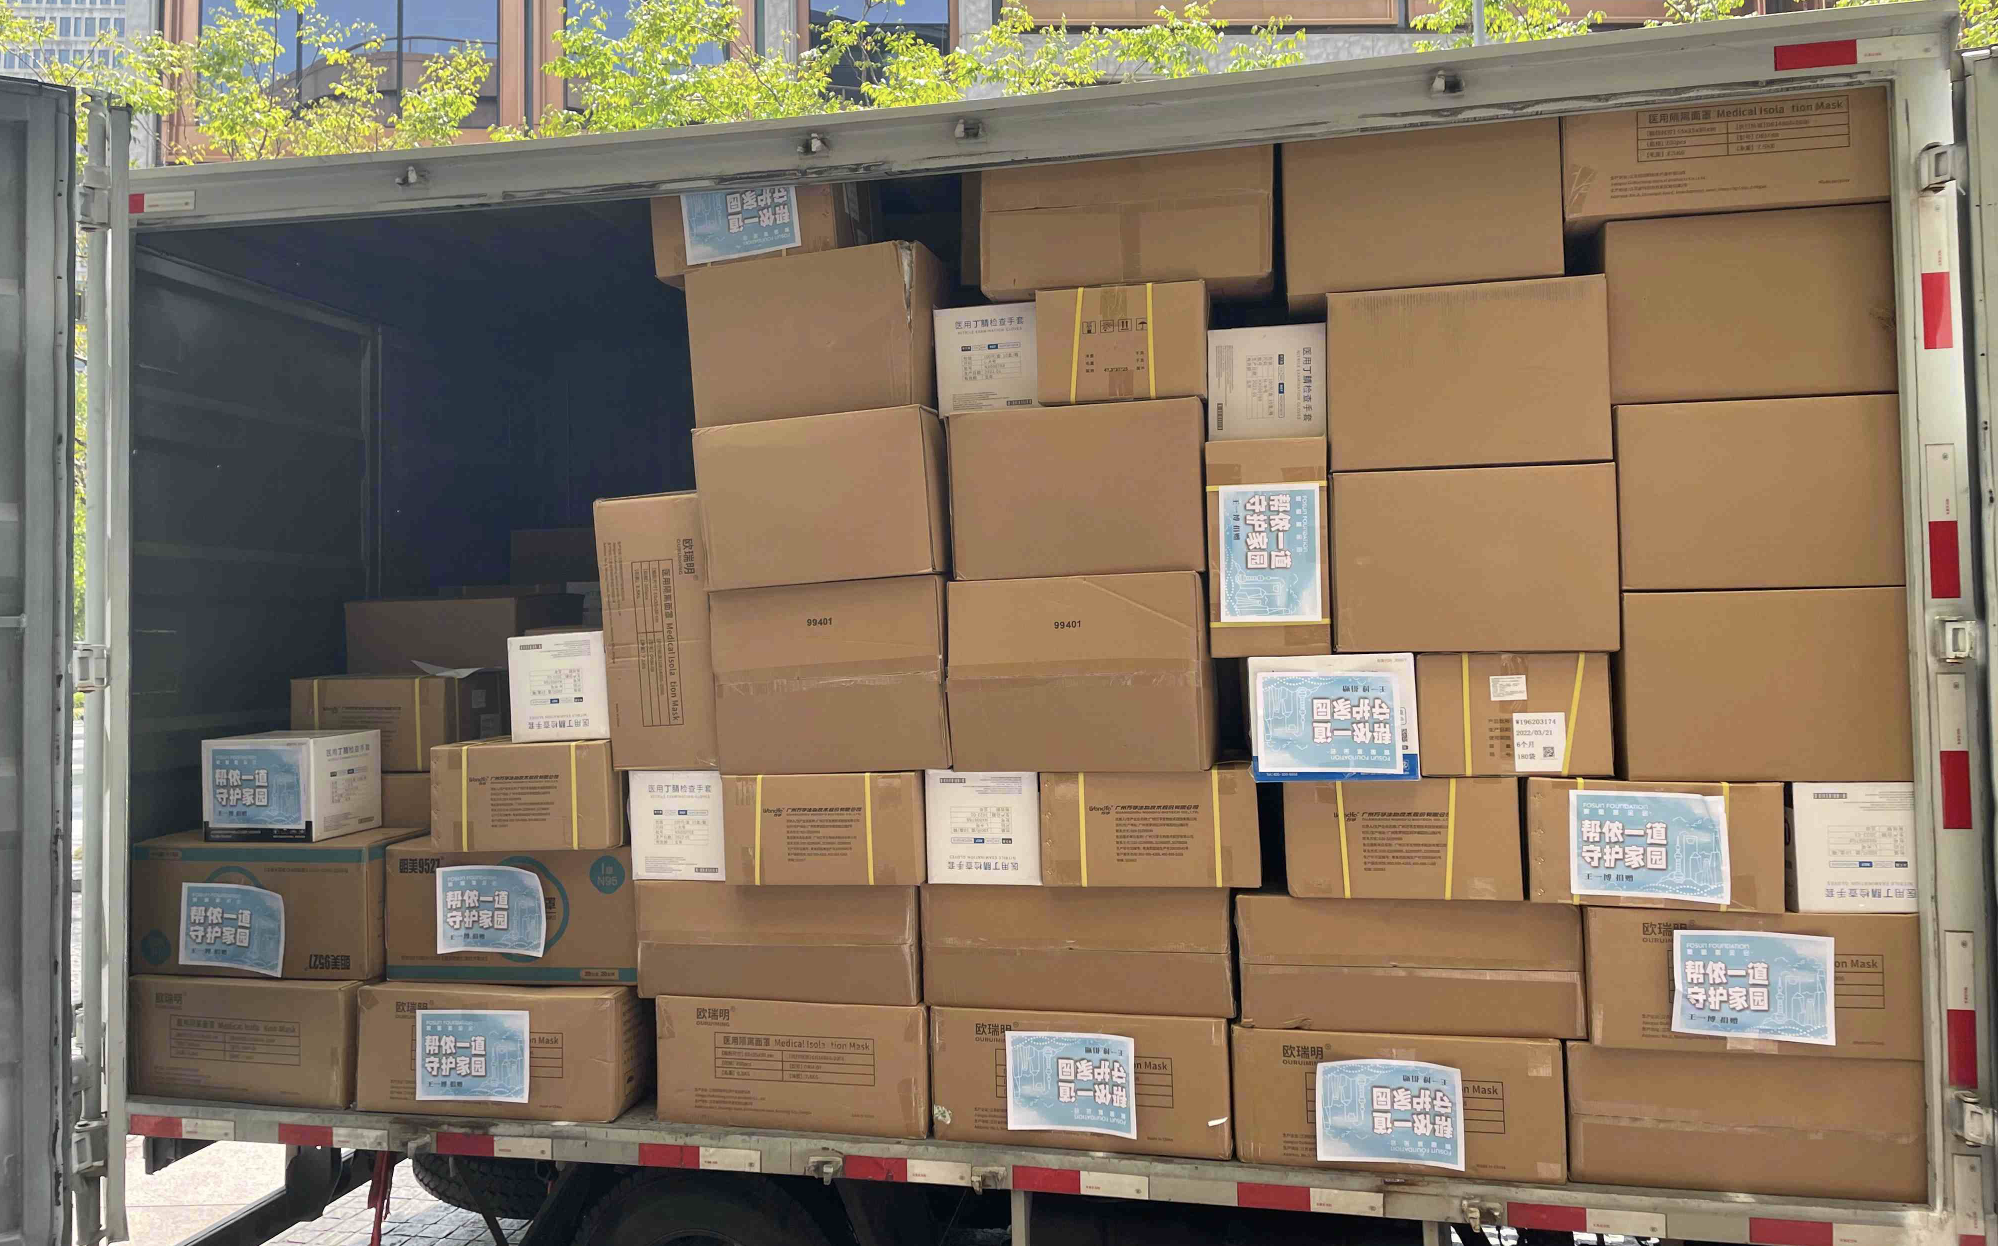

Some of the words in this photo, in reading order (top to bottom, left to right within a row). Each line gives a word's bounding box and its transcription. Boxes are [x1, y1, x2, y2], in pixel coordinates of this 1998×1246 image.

[1717, 103, 1757, 118] Medical
[1759, 102, 1785, 115] Isola
[1792, 101, 1813, 112] tion
[1815, 100, 1843, 111] Mask
[728, 204, 790, 233] 帮侬一道
[1245, 494, 1268, 569] 守护家园
[1269, 494, 1292, 569] 帮侬一道
[682, 538, 695, 575] 欧瑞明
[806, 617, 832, 626] 99401
[1054, 620, 1082, 629] 99401
[666, 622, 676, 656] Medical
[669, 681, 678, 698] tion
[671, 700, 680, 721] Mask
[1312, 697, 1390, 721] 守护家园
[1312, 721, 1392, 744] 帮侬一道
[214, 768, 268, 787] 帮侬一道
[216, 788, 269, 806] 守护家园
[1581, 819, 1668, 845] 帮侬一道
[1581, 845, 1668, 870] 守护家园
[596, 876, 618, 887] N95
[1585, 872, 1612, 882] 王一博
[446, 890, 509, 910] 帮侬一道
[189, 906, 252, 928] 帮侬一道
[446, 910, 509, 930] 守护家园
[188, 926, 250, 948] 守护家园
[1685, 960, 1770, 986] 帮侬一道
[1850, 959, 1878, 969] Mask
[395, 1001, 428, 1013] 欧瑞明
[1686, 986, 1770, 1012] 守护家园
[696, 1007, 730, 1021] 欧瑞明
[1688, 1013, 1716, 1023] 王一博
[424, 1035, 487, 1056] 帮侬一道
[538, 1036, 558, 1045] Mask
[723, 1035, 771, 1047] 医用隔离面罩
[774, 1038, 805, 1049] Medical
[807, 1040, 826, 1049] Isola
[830, 1041, 847, 1050] tion
[849, 1042, 870, 1051] Mask
[1282, 1044, 1324, 1060] 欧瑞明
[424, 1056, 487, 1077] 守护家园
[1057, 1058, 1127, 1085] 守护家园
[1144, 1061, 1167, 1071] Mask
[1057, 1081, 1128, 1109] 帮侬一道
[1372, 1086, 1452, 1113] 守护家园
[1472, 1085, 1498, 1096] Mask
[1372, 1111, 1454, 1139] 帮侬一道
